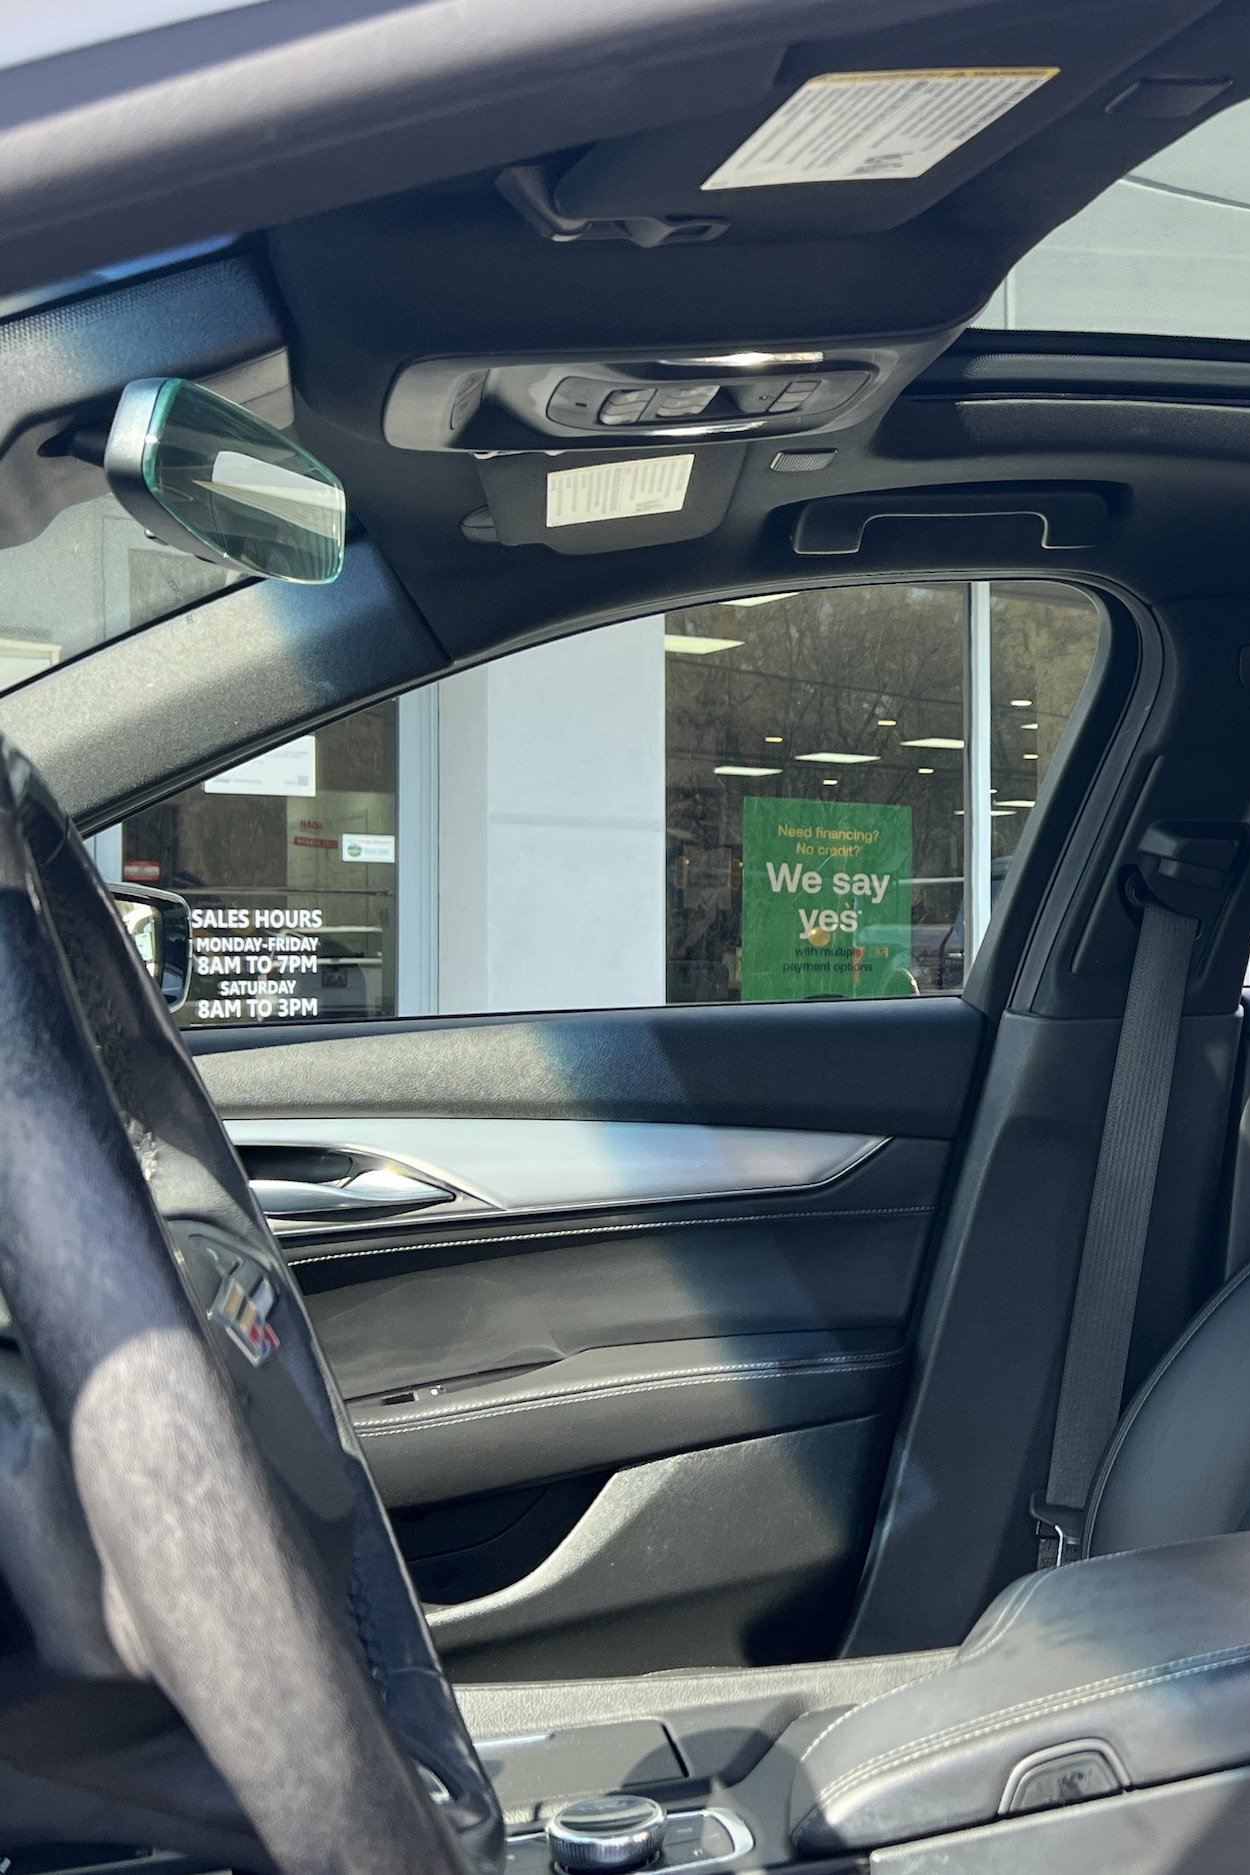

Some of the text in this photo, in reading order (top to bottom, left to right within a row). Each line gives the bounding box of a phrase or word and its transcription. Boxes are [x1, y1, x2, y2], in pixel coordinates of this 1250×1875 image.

[778, 824, 880, 844] Need financing?
[796, 842, 861, 857] No credit?
[766, 862, 890, 904] We say
[191, 909, 322, 928] SALES HOURS
[196, 937, 319, 952] MONDAY-FRIDAY
[795, 946, 818, 957] with
[197, 955, 318, 975] 8AM TO 7PM
[783, 961, 873, 975] payment options
[220, 980, 296, 996] SATURDAY
[198, 998, 318, 1019] 8AM TO 3PM
